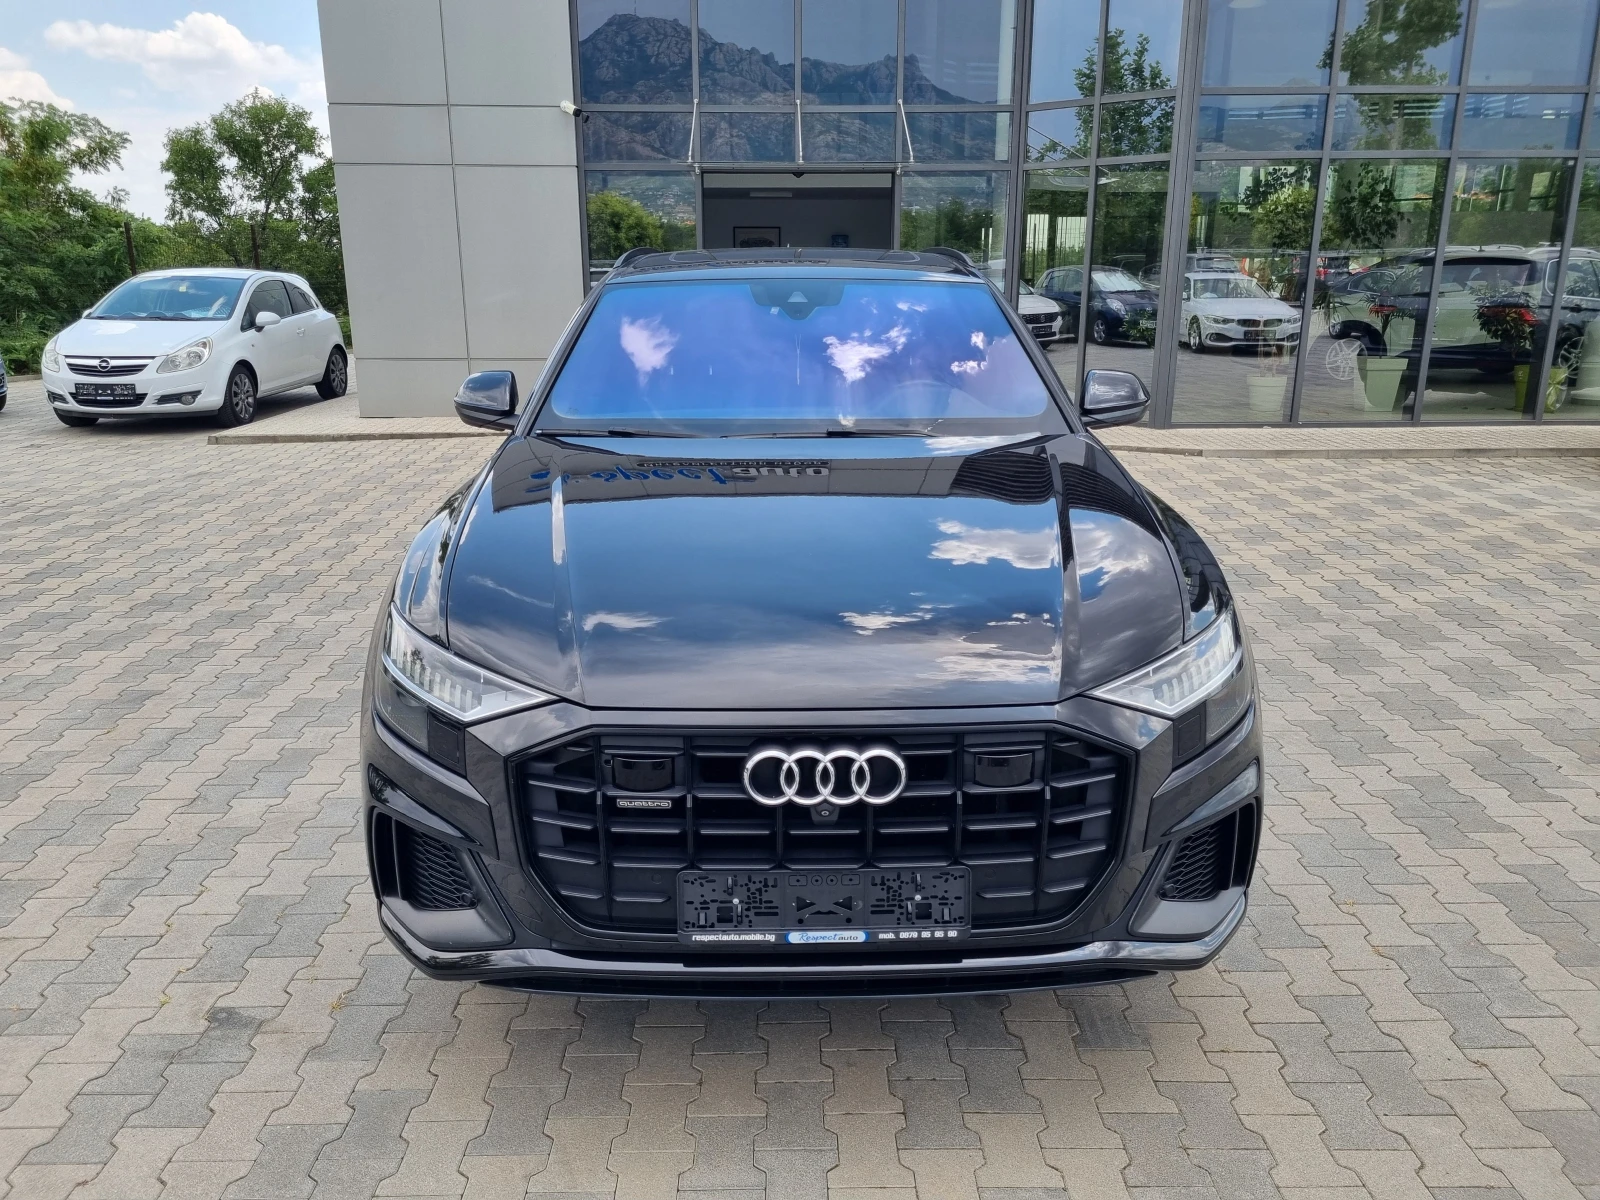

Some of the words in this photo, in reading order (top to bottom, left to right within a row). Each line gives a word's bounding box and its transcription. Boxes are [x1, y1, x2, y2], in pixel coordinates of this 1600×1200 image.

[691, 933, 776, 942] respectauto.mobile.bg
[798, 932, 842, 942] Respect
[899, 931, 918, 939] 0879
